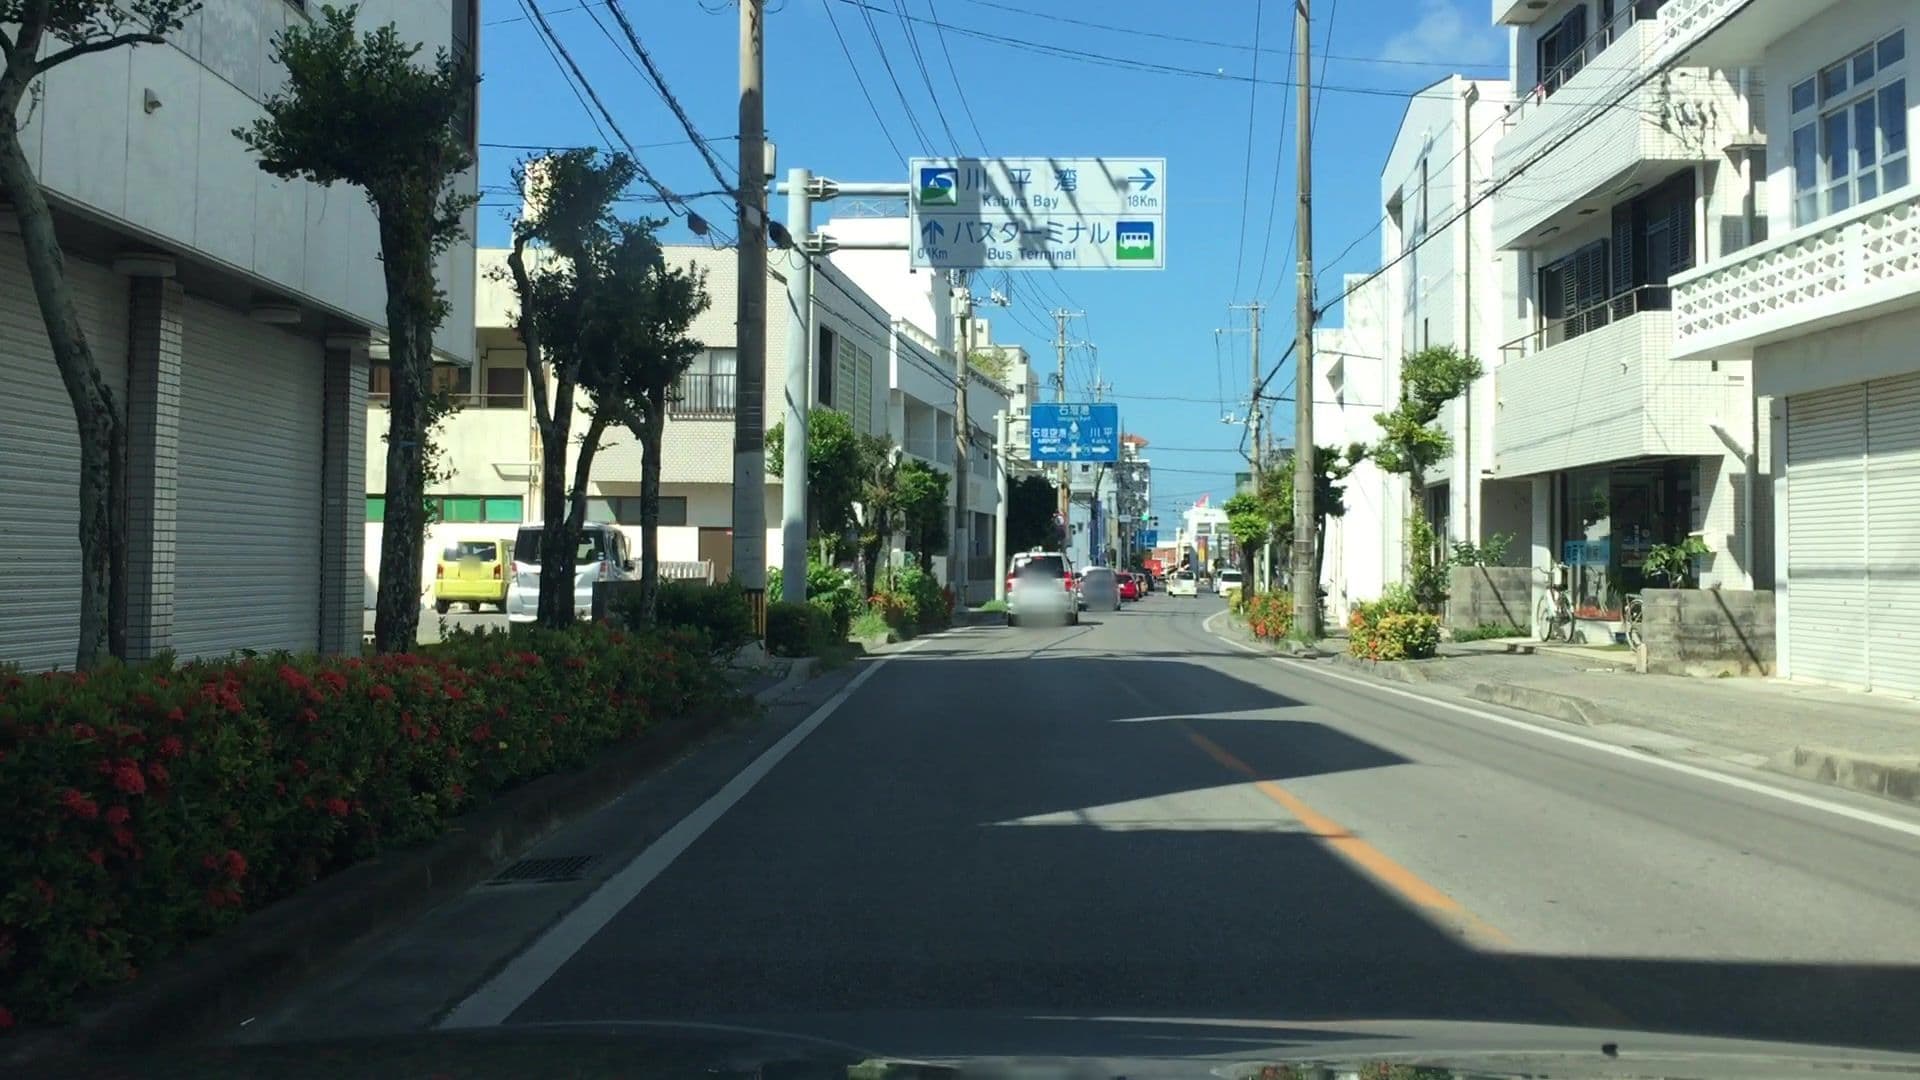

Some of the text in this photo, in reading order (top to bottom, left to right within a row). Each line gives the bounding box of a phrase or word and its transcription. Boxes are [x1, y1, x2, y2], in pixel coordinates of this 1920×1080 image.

[966, 168, 1077, 191] 川平湾
[982, 195, 1059, 209] Kabira Bay
[1127, 196, 1158, 207] 18Km
[953, 221, 1111, 245] バスターミナル
[988, 247, 1076, 260] Bus Terminal
